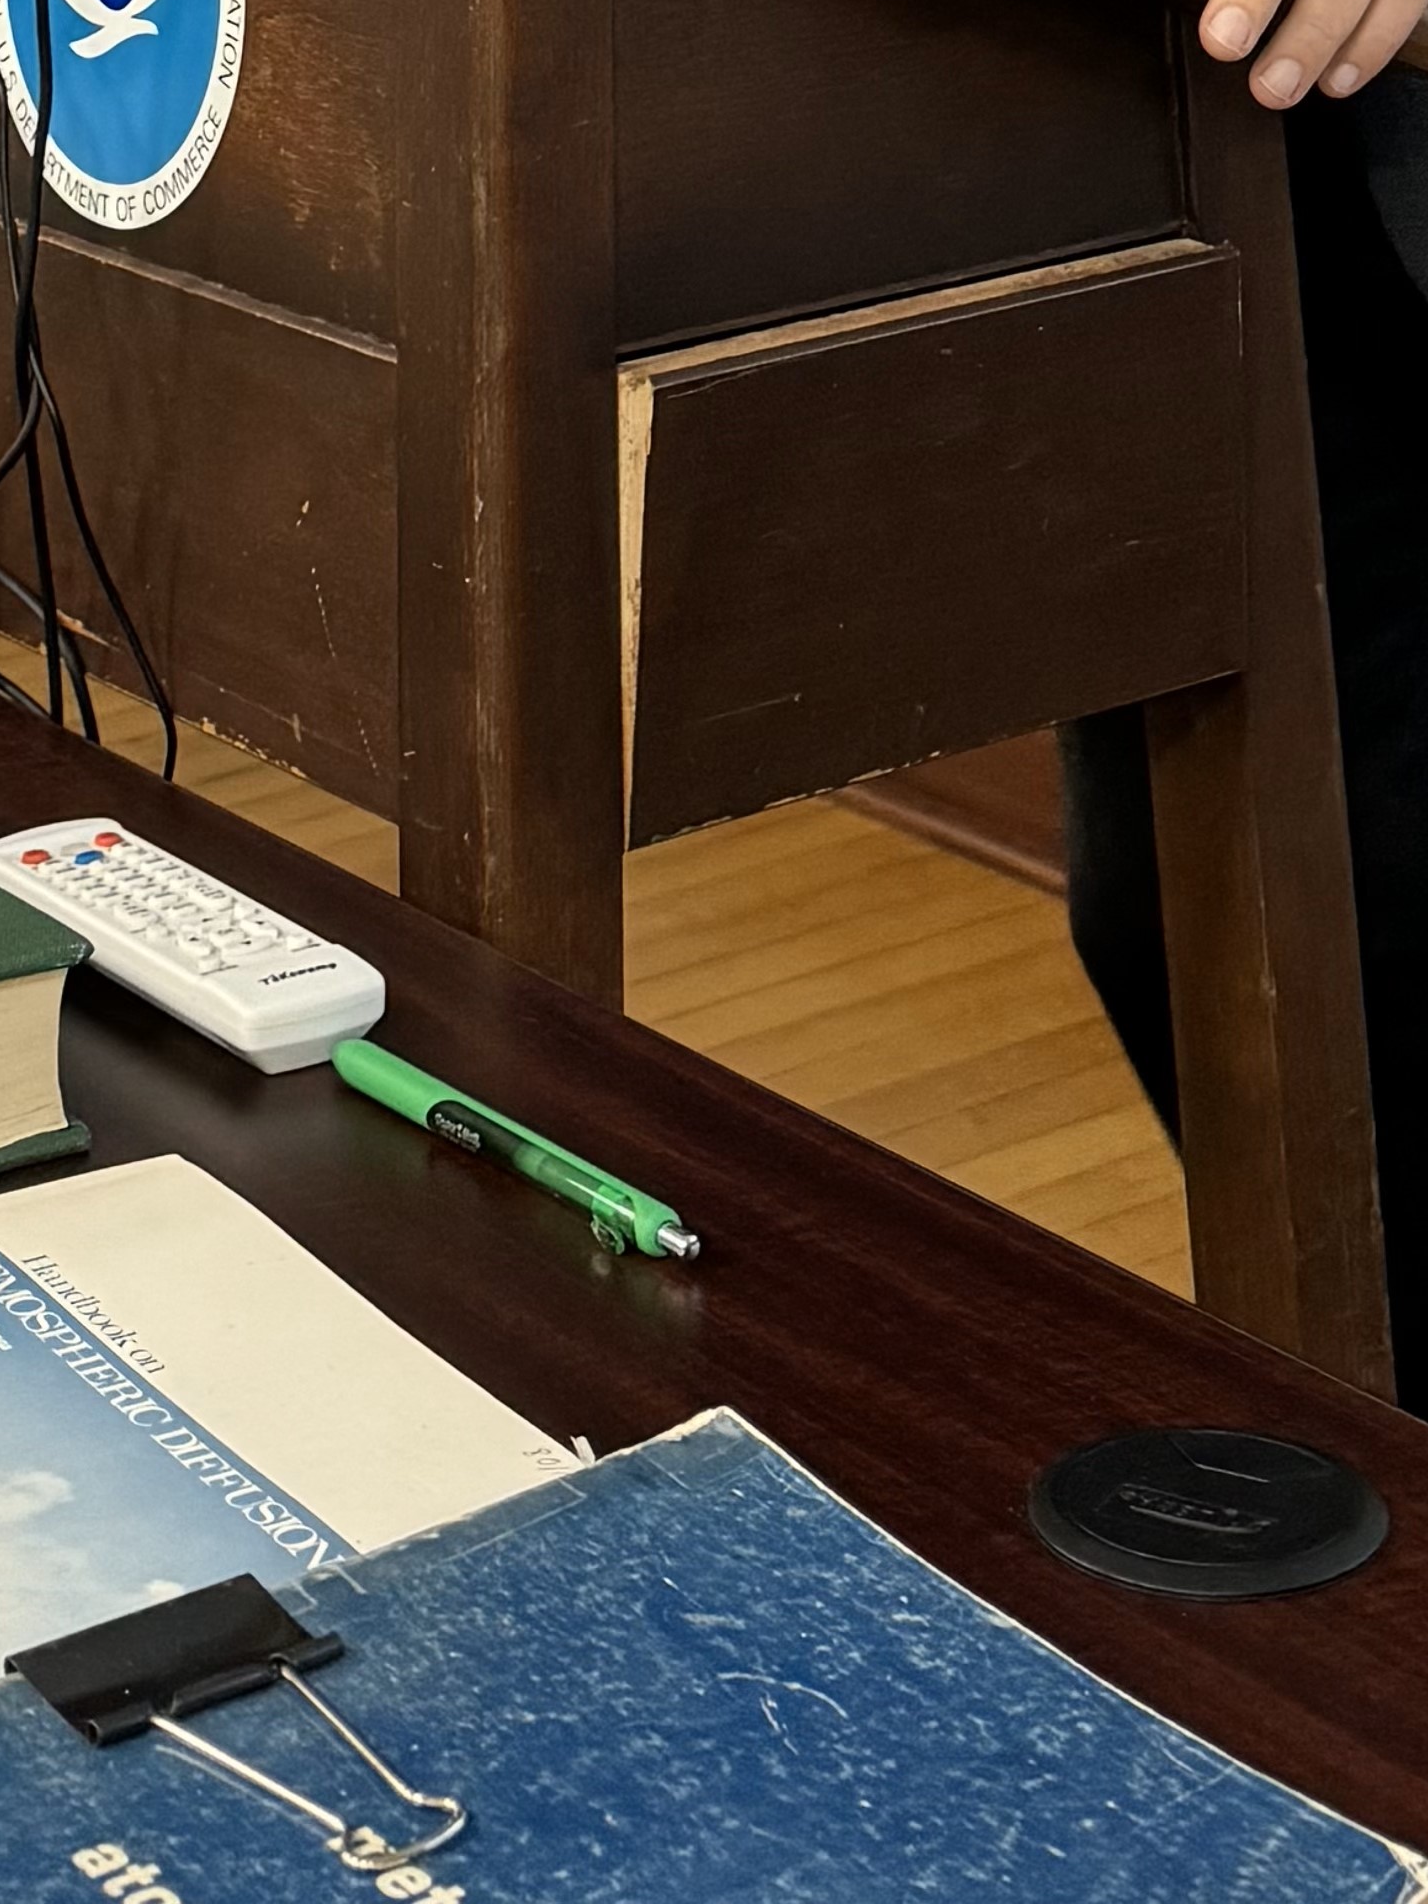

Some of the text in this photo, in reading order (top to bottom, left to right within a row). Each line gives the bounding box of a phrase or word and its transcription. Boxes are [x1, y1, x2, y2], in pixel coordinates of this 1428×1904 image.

[15, 97, 110, 218] DERTMENT
[115, 195, 137, 222] OF
[142, 104, 222, 216] COMMERCE
[22, 1253, 166, 1374] Handbook on
[149, 1426, 345, 1571] DIFFUSION
